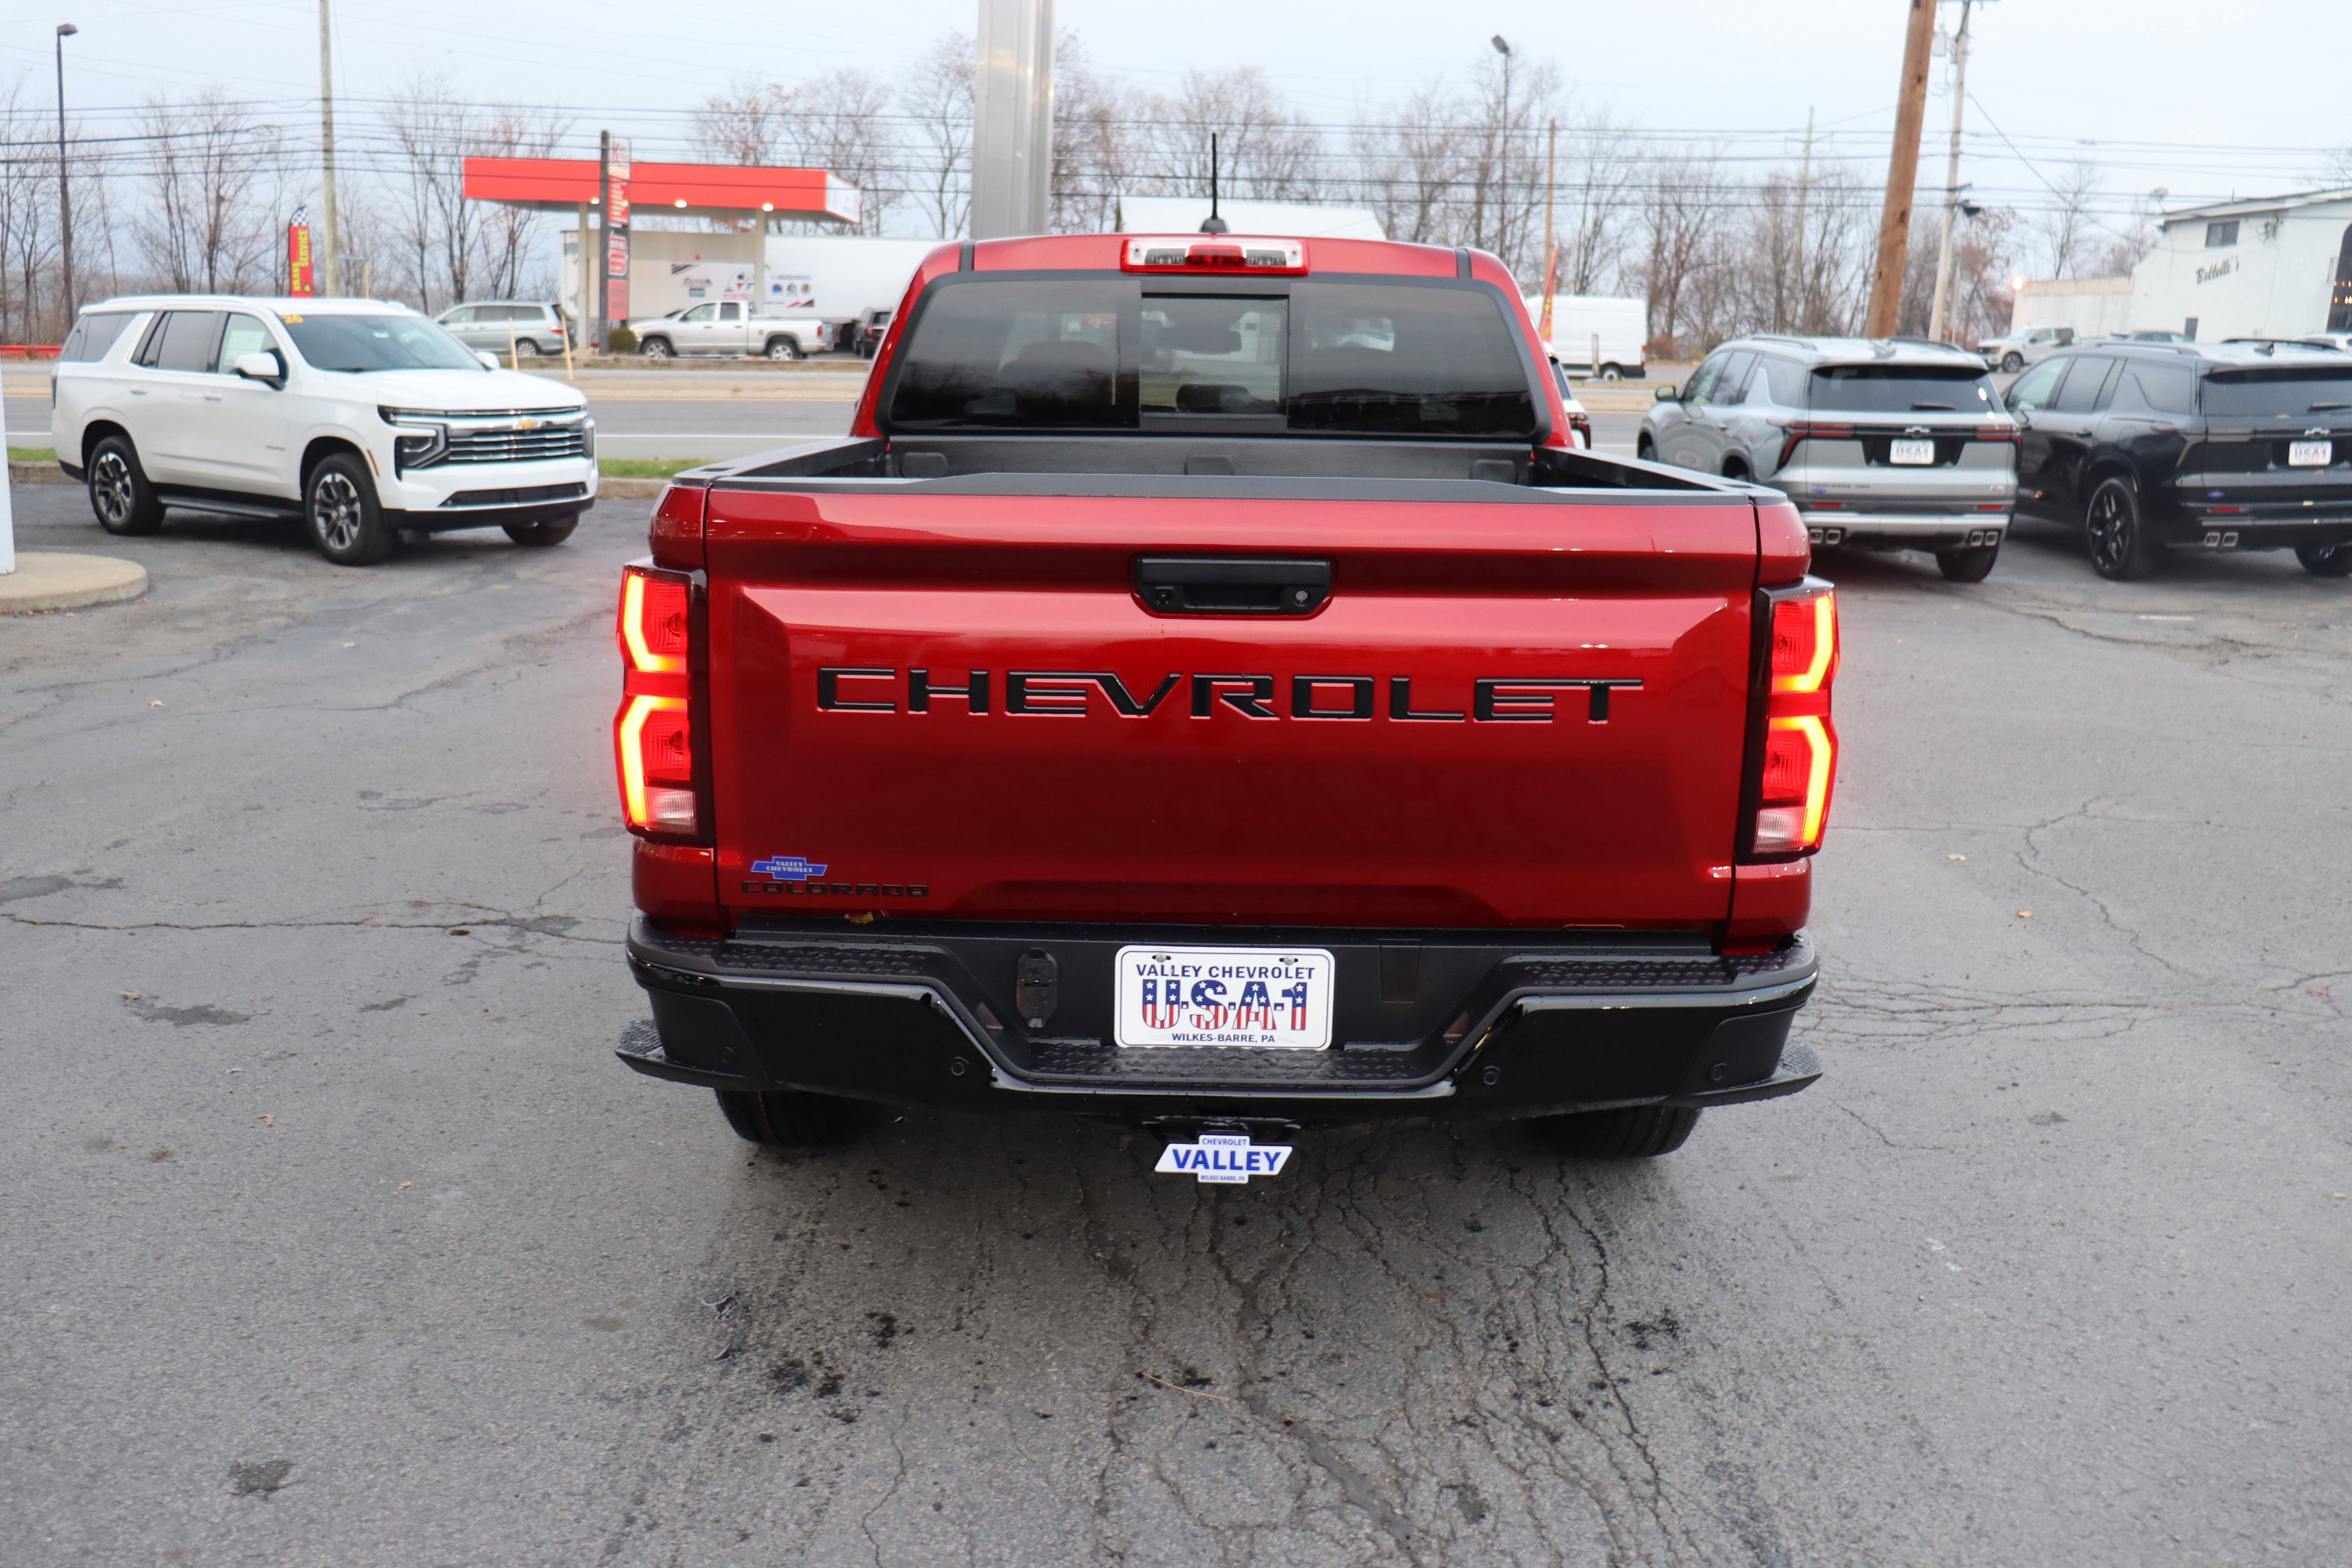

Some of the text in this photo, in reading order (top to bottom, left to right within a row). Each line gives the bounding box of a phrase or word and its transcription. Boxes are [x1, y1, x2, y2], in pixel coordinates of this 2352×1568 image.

[298, 229, 309, 267] SERVICE
[817, 667, 1642, 724] CHEVROLET
[742, 881, 928, 896] COLORADO
[1136, 964, 1315, 979] VALLEY CHEVROLET
[1172, 1033, 1258, 1044] WILKES-BARRE,
[1172, 1149, 1281, 1171] VALLEY
